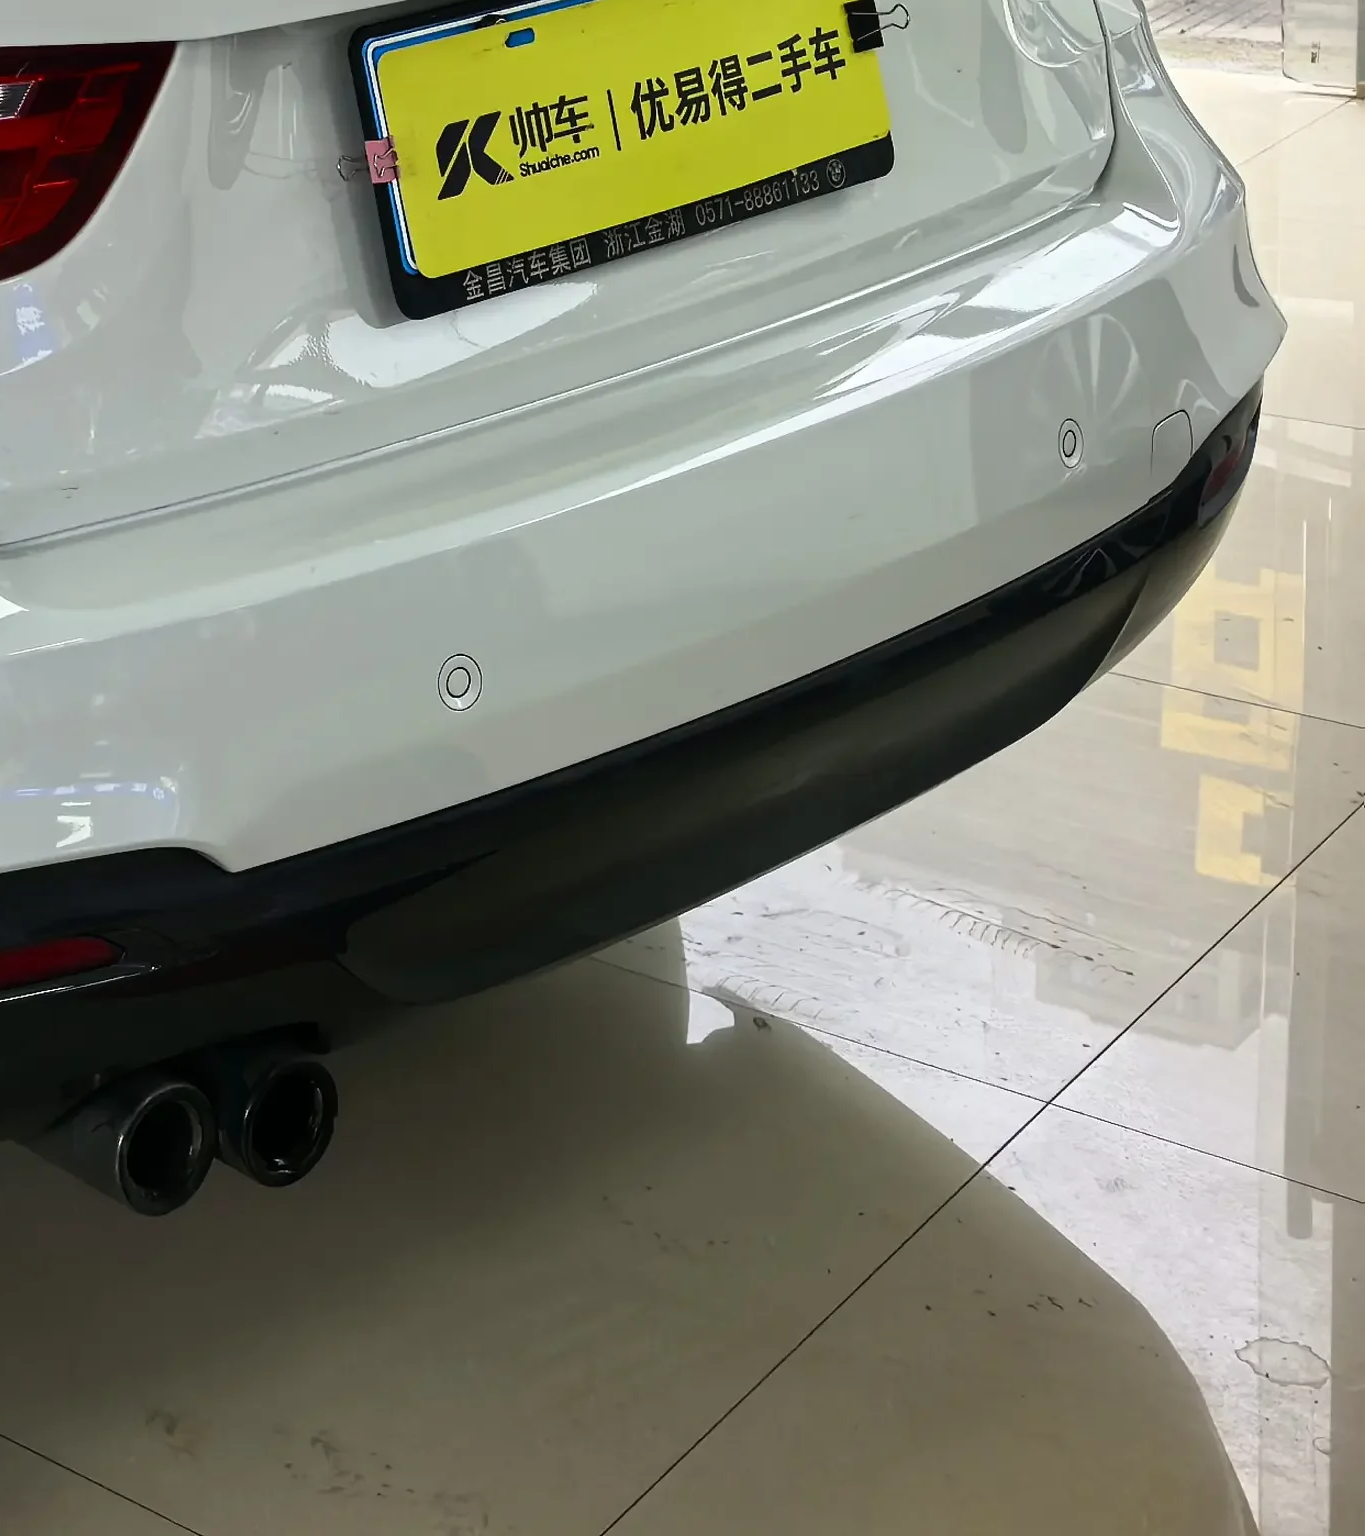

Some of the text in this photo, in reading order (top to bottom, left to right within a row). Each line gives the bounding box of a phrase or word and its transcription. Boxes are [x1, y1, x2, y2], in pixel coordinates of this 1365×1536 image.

[509, 95, 595, 158] 帅车
[631, 27, 846, 140] 优易得二手车
[462, 169, 820, 301] 金昌汽车集团 浙江金湖 0571-88861133
